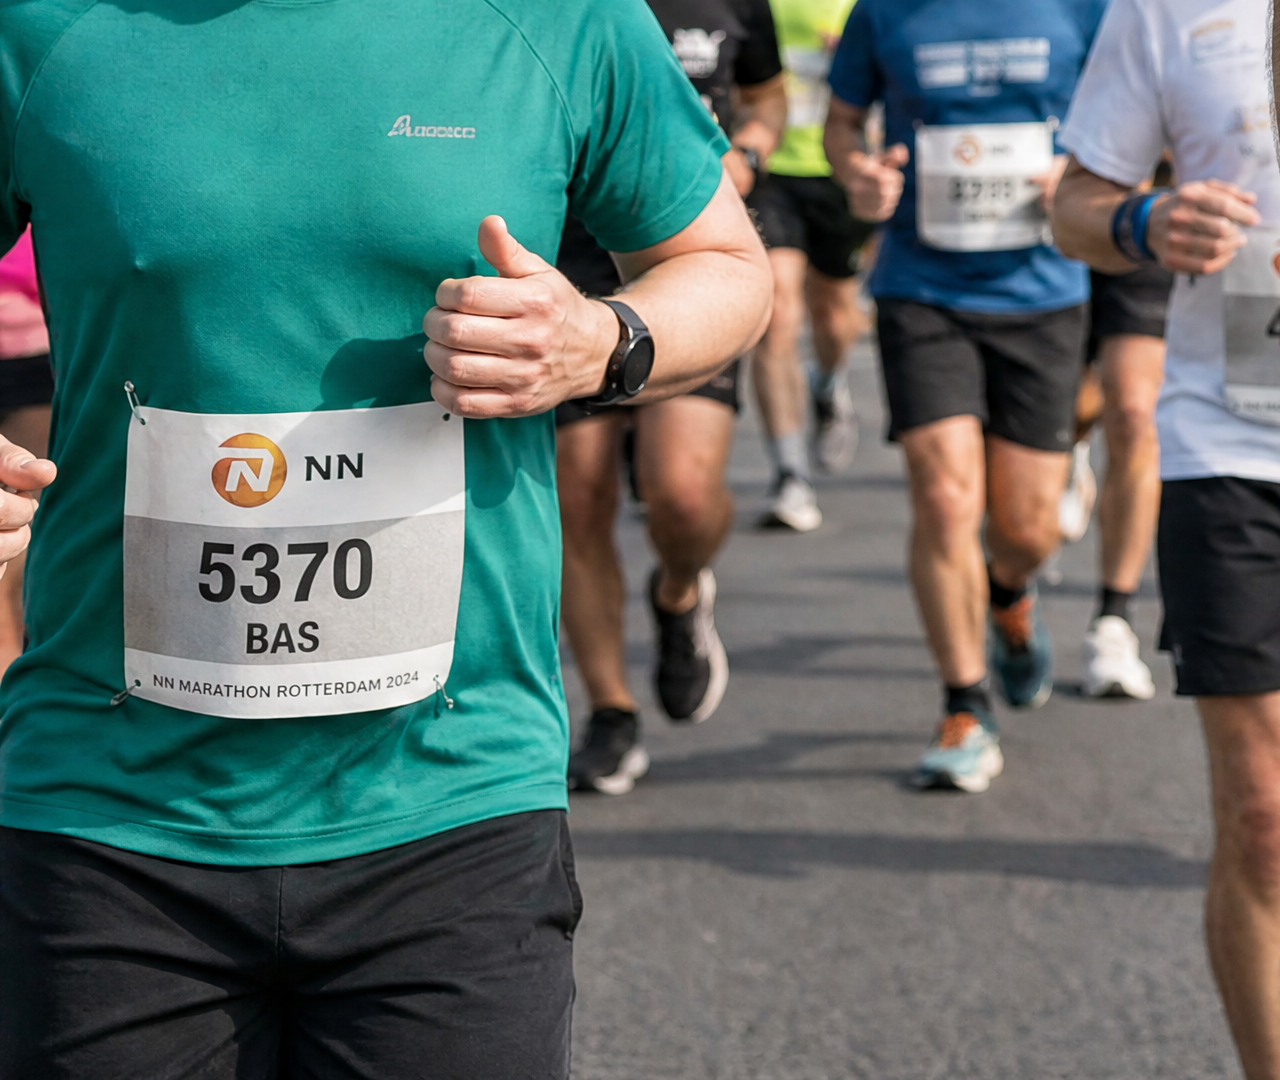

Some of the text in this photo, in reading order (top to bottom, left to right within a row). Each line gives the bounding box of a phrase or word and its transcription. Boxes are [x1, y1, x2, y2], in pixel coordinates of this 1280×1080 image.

[304, 452, 364, 482] NN
[198, 538, 373, 605] 5370
[246, 621, 320, 654] BAS
[153, 670, 420, 699] NN MARATHON ROTTERDAM 2024
